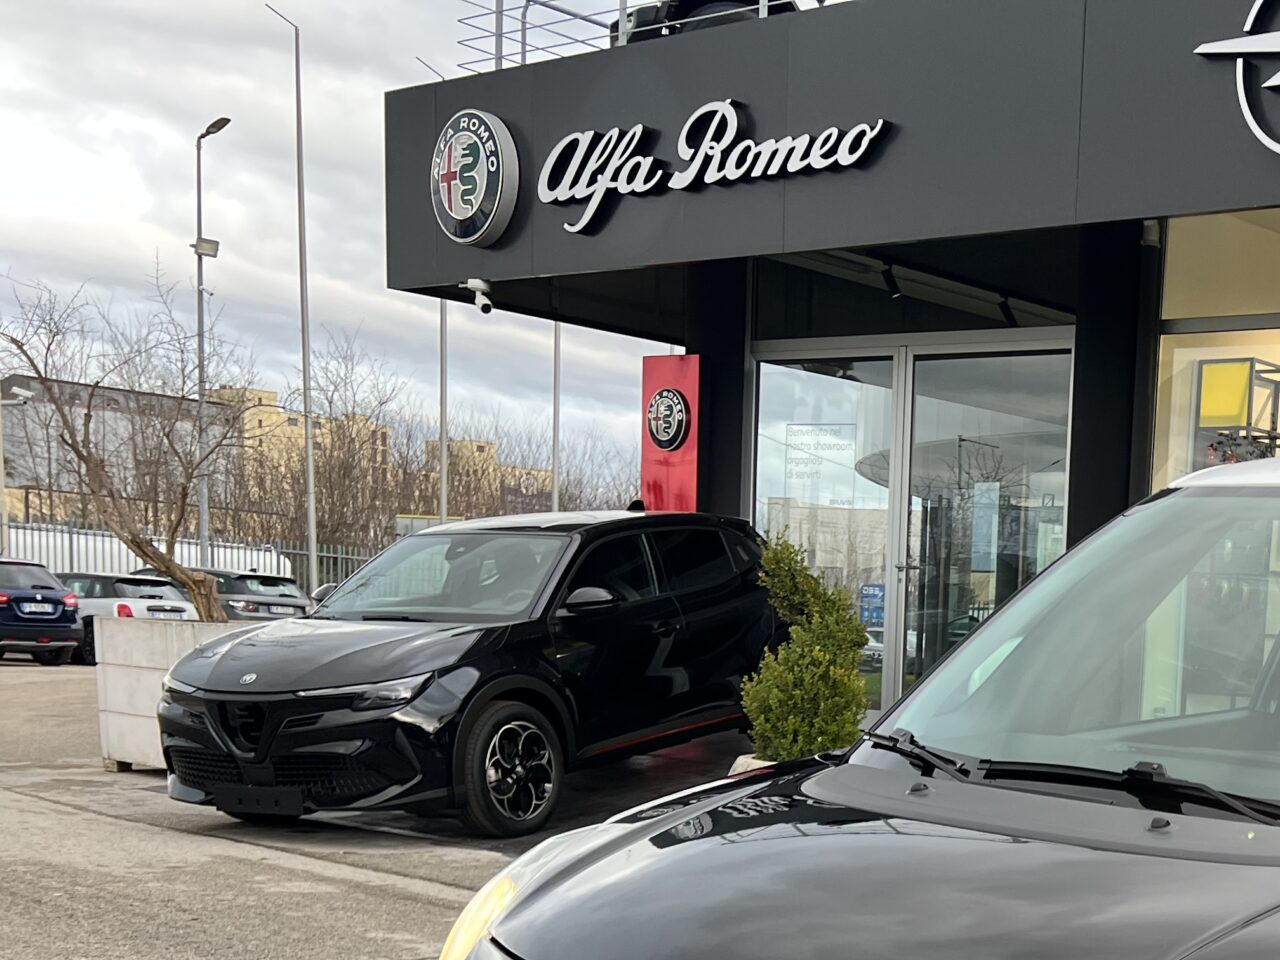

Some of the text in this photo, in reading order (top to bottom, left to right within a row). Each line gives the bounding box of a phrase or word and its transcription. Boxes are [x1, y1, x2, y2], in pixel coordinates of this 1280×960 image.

[433, 117, 498, 181] ALFA ROMEO
[537, 98, 884, 233] Alfa Romeo
[662, 390, 683, 420] ROMEO
